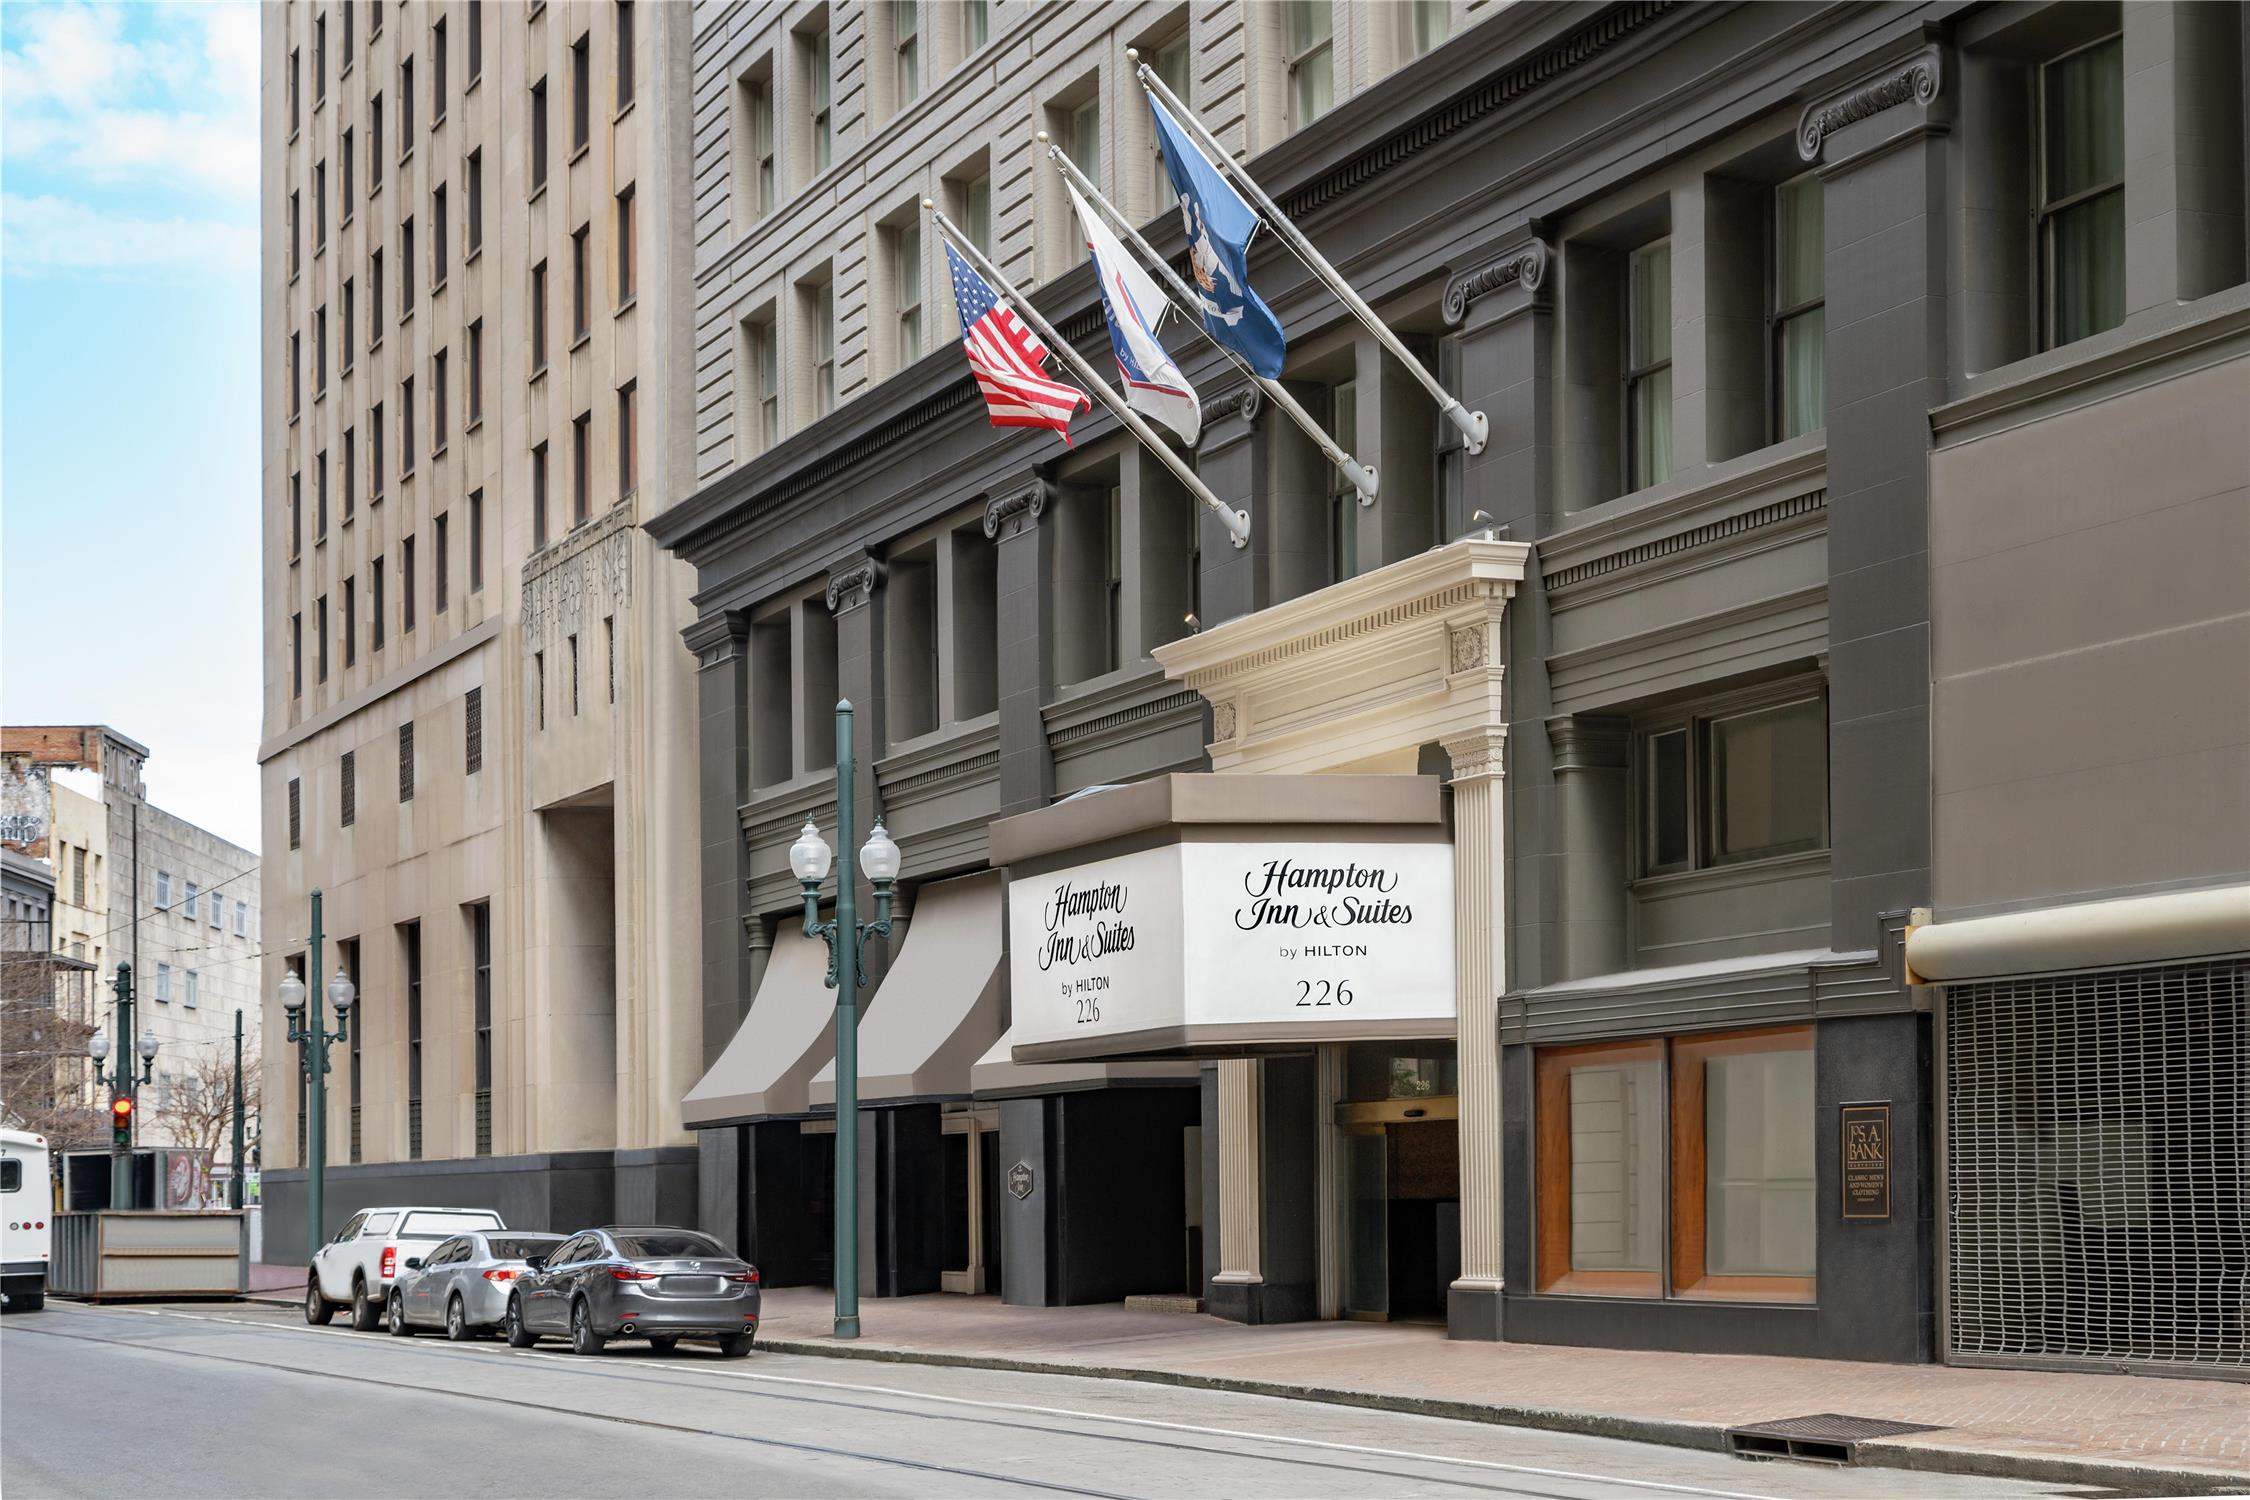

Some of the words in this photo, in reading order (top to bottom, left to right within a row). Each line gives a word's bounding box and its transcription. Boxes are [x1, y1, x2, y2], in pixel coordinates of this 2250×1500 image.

[1244, 858, 1398, 897] Hampton
[1044, 880, 1128, 931] Hampton
[1234, 897, 1312, 931] Inn
[1313, 905, 1332, 928] &
[1331, 896, 1412, 926] Suites
[1038, 930, 1082, 971] Inn
[1081, 934, 1092, 962] &
[1090, 920, 1135, 959] Suites
[1279, 946, 1298, 960] by
[1304, 945, 1368, 957] HILTON
[1061, 981, 1073, 998] by
[1075, 976, 1110, 993] HILTON
[1295, 979, 1354, 1007] 226
[1076, 997, 1100, 1024] 226
[1416, 1080, 1430, 1090] 226
[1849, 1143, 1883, 1160] BANK
